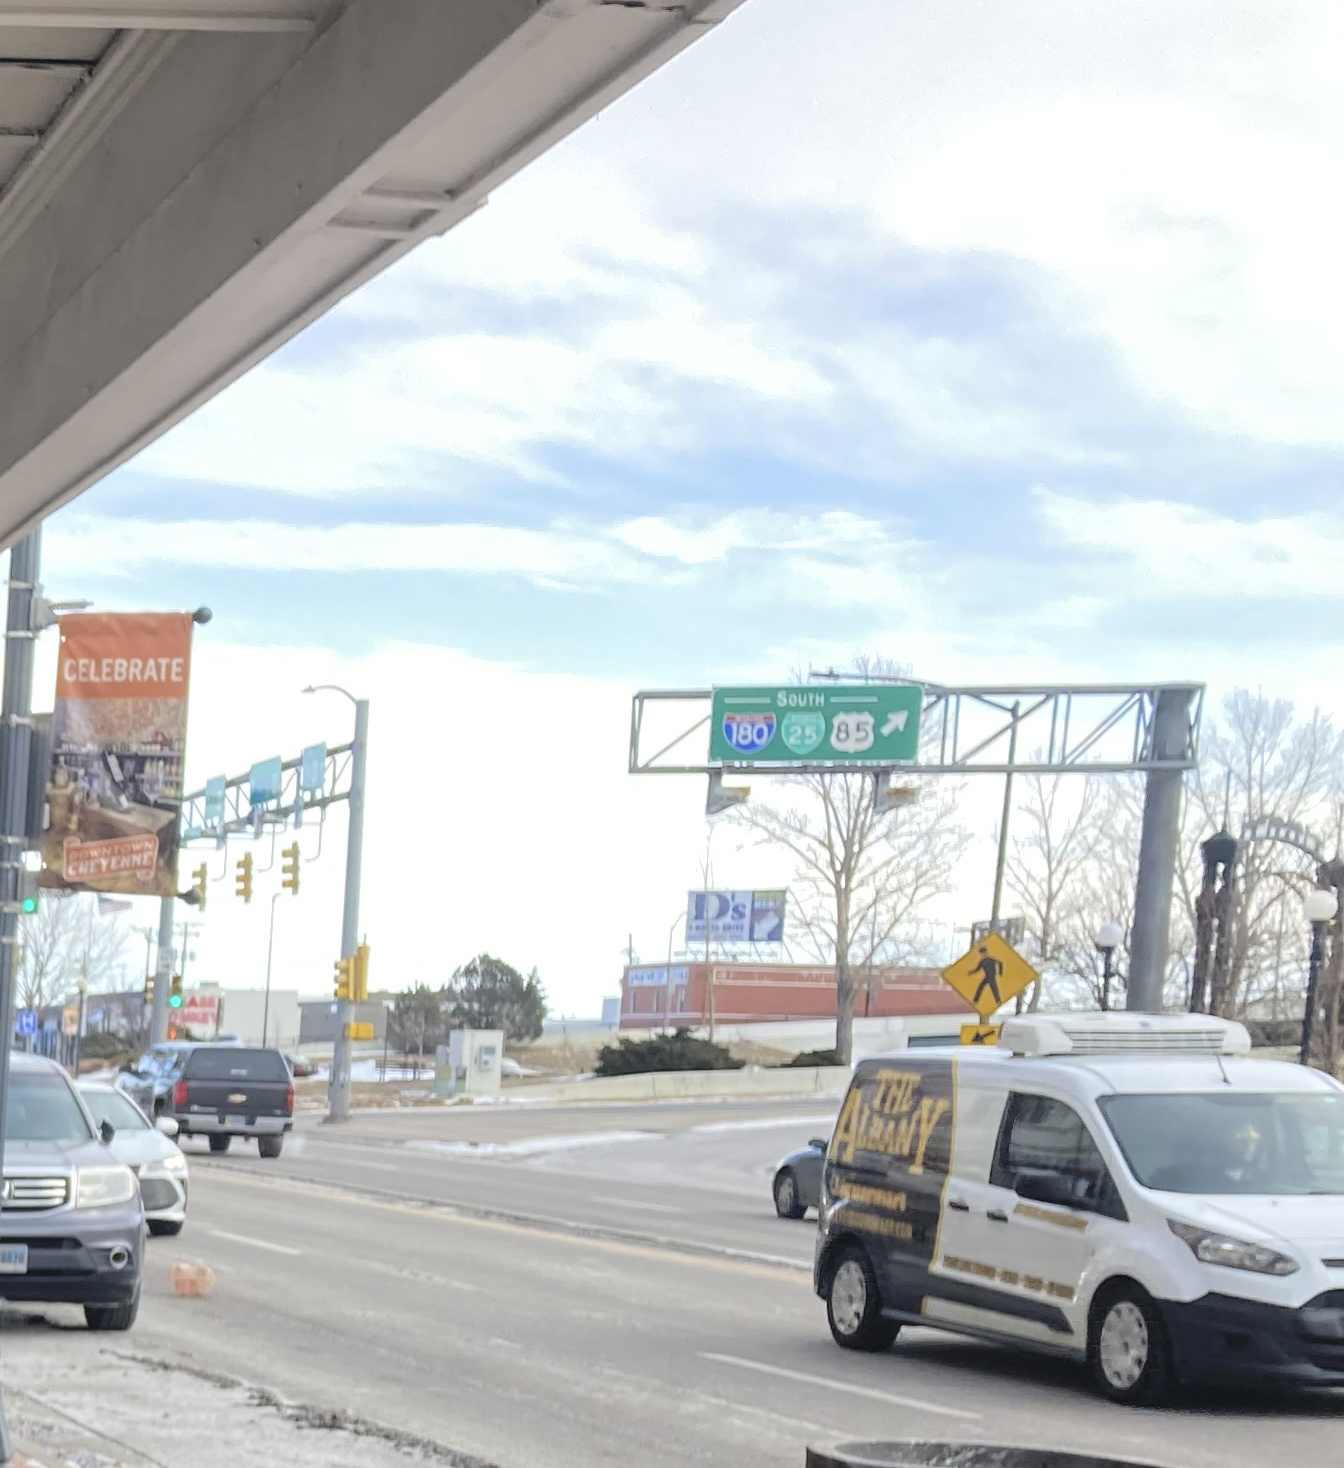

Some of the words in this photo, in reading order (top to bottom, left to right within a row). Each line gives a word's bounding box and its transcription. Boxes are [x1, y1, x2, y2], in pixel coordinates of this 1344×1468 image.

[64, 657, 184, 683] CELEBRATE
[776, 690, 825, 707] SOUTH
[730, 723, 769, 746] 180
[789, 726, 818, 745] 25
[835, 721, 870, 744] 85
[68, 841, 154, 860] DOWNTOWN
[67, 851, 154, 877] CHEYENNE
[872, 1068, 922, 1114] THE
[828, 1087, 950, 1176] ALBANY
